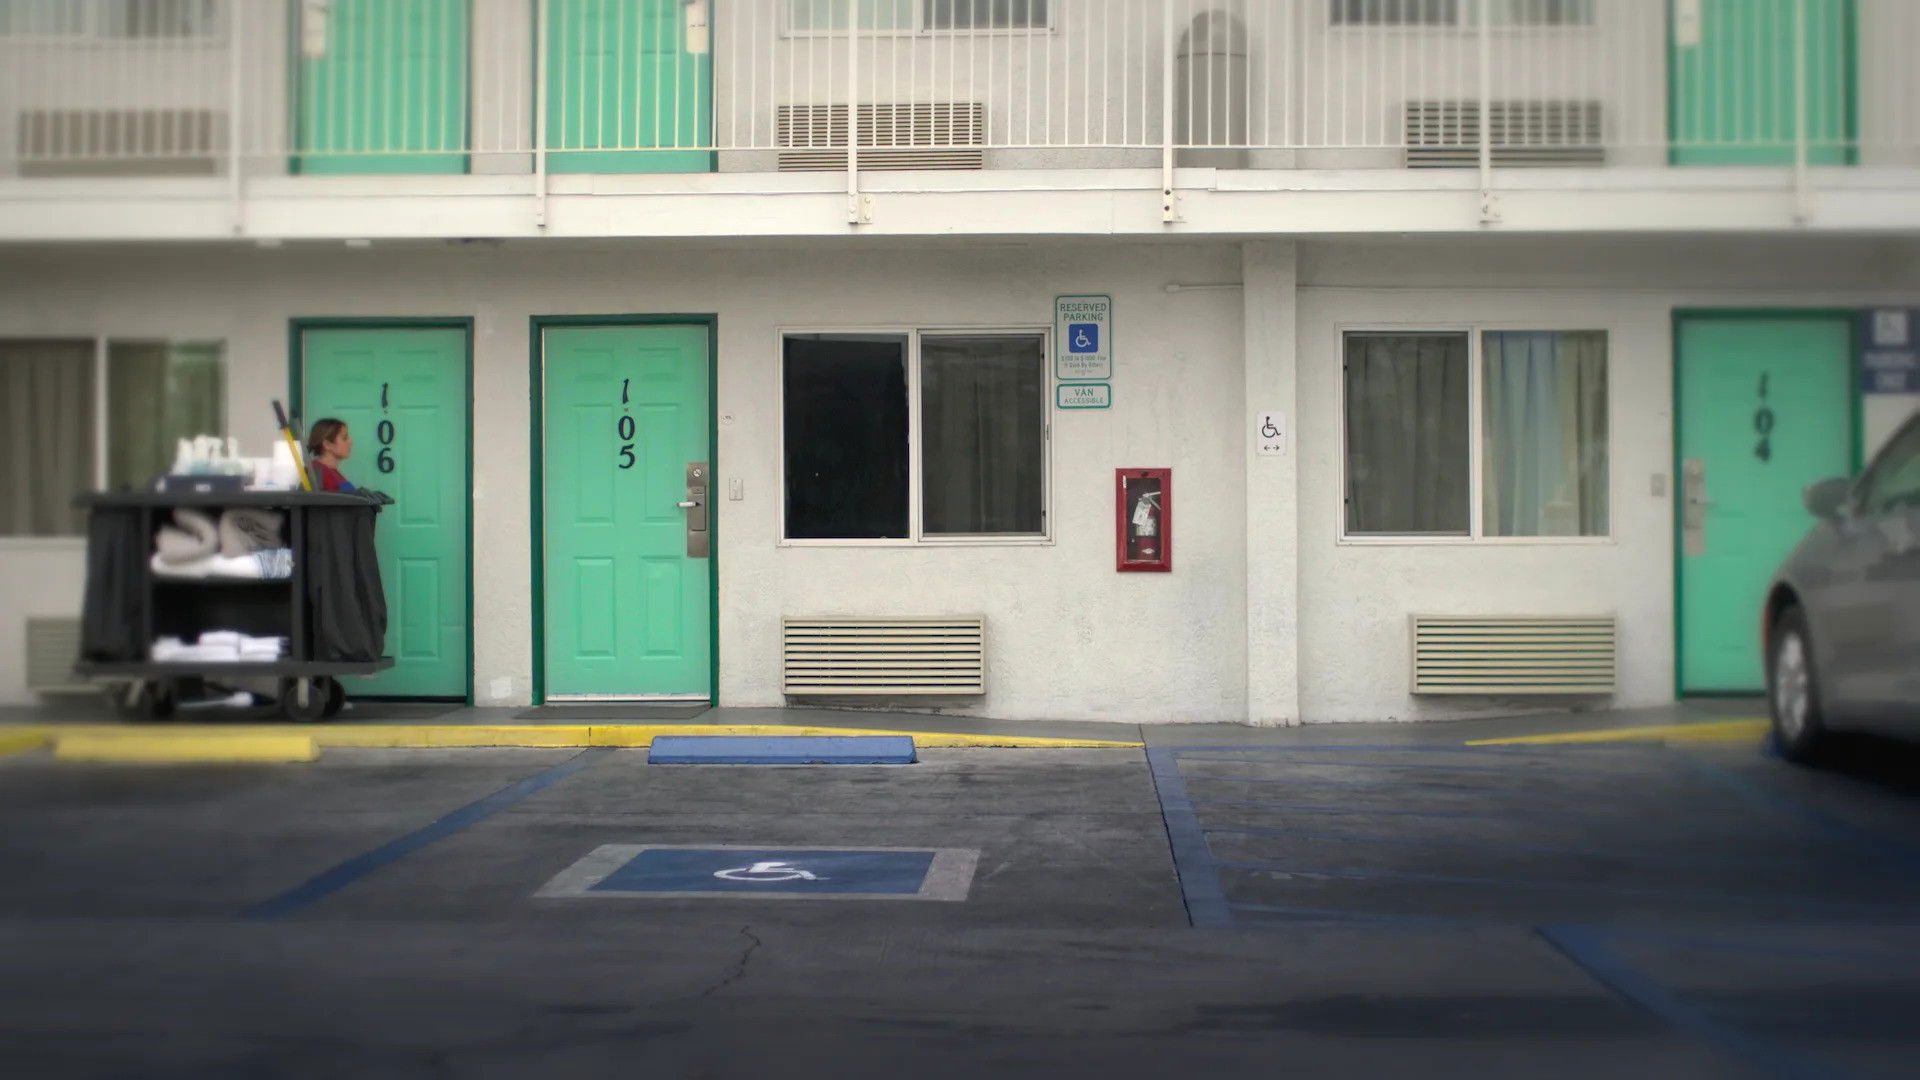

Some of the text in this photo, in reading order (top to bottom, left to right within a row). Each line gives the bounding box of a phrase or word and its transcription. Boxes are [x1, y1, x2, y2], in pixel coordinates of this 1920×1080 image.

[1060, 303, 1107, 312] RESERVED
[1063, 312, 1104, 321] PARKING
[1074, 388, 1094, 397] VAN
[1063, 397, 1104, 405] ACCESSIBLE
[1753, 371, 1775, 464] 104
[376, 382, 396, 474] 106
[618, 378, 636, 470] 105
